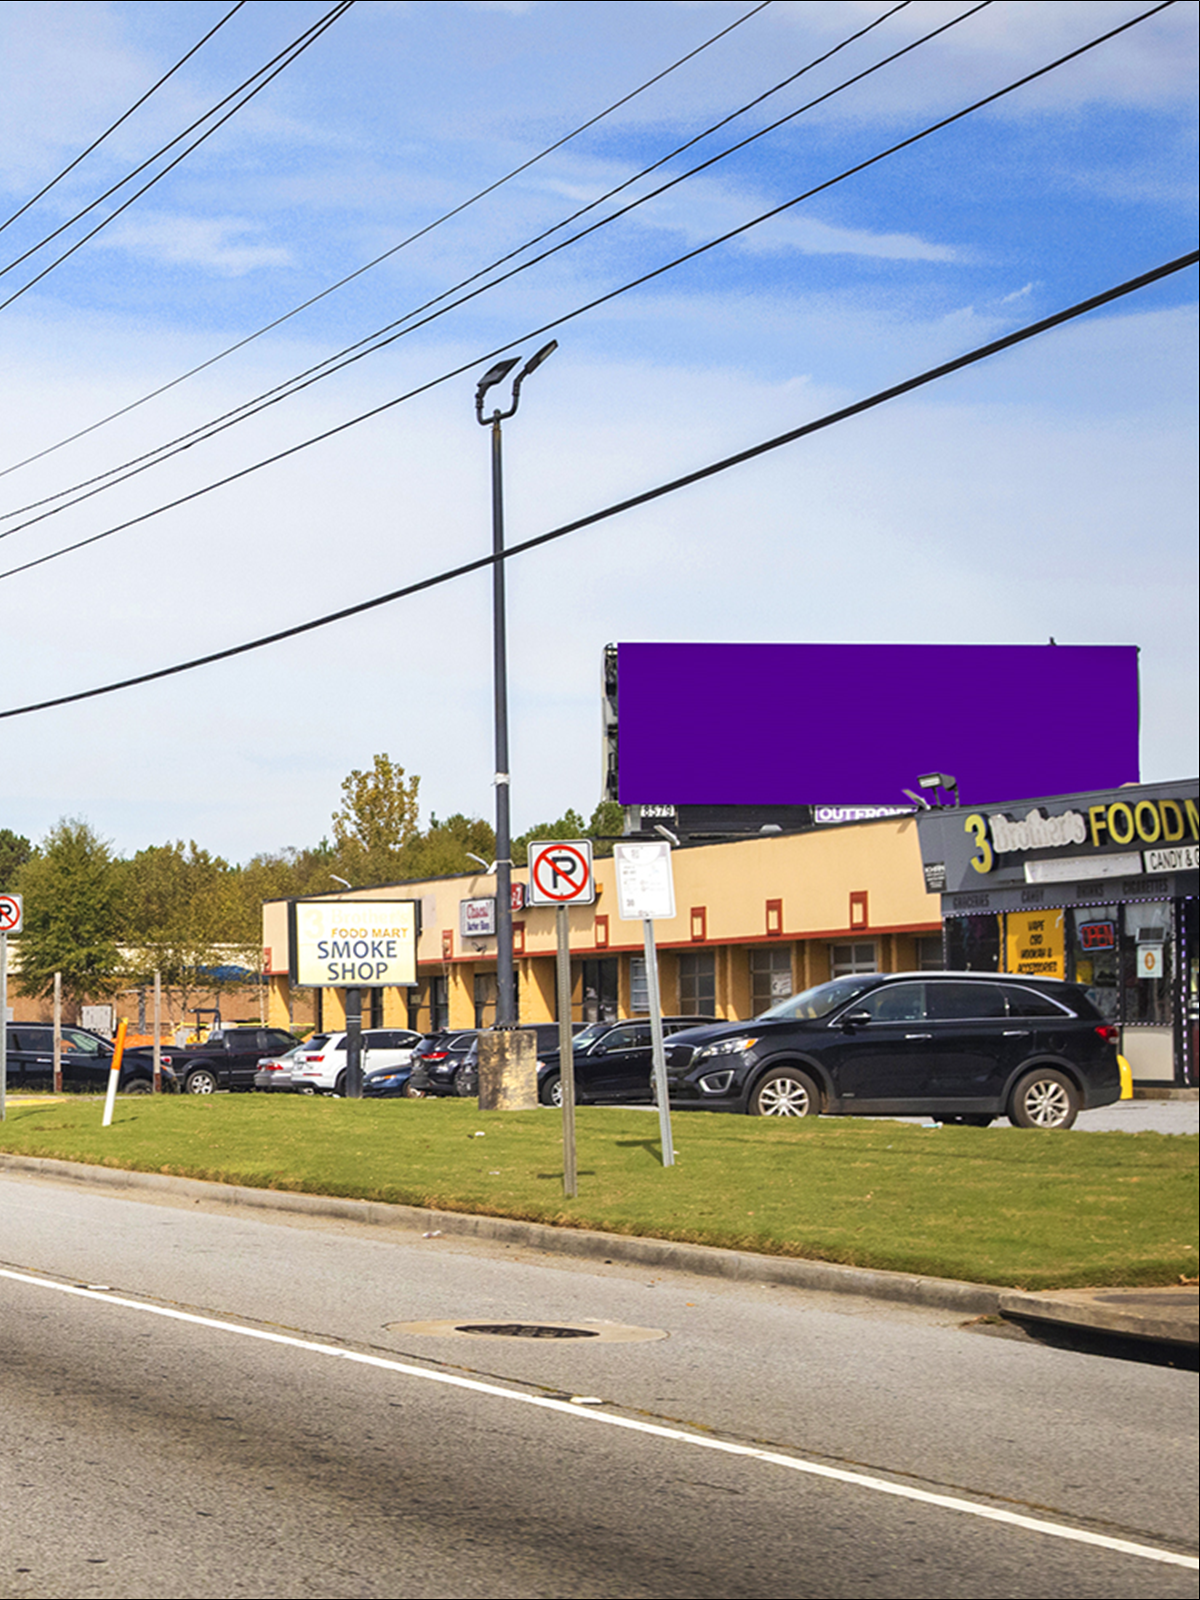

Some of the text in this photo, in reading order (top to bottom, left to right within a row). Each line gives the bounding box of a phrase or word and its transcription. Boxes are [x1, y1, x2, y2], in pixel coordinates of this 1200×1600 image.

[965, 814, 993, 874] 3
[1089, 800, 1184, 847] FOOD
[1150, 850, 1182, 870] CANDY
[1185, 849, 1193, 866] &
[1122, 877, 1169, 895] CIGARETTES
[1021, 888, 1044, 903] CANDY
[331, 928, 408, 938] FOOD MART
[1081, 925, 1114, 948] OPEN
[317, 940, 397, 959] SMOKE
[328, 962, 388, 980] SHOP
